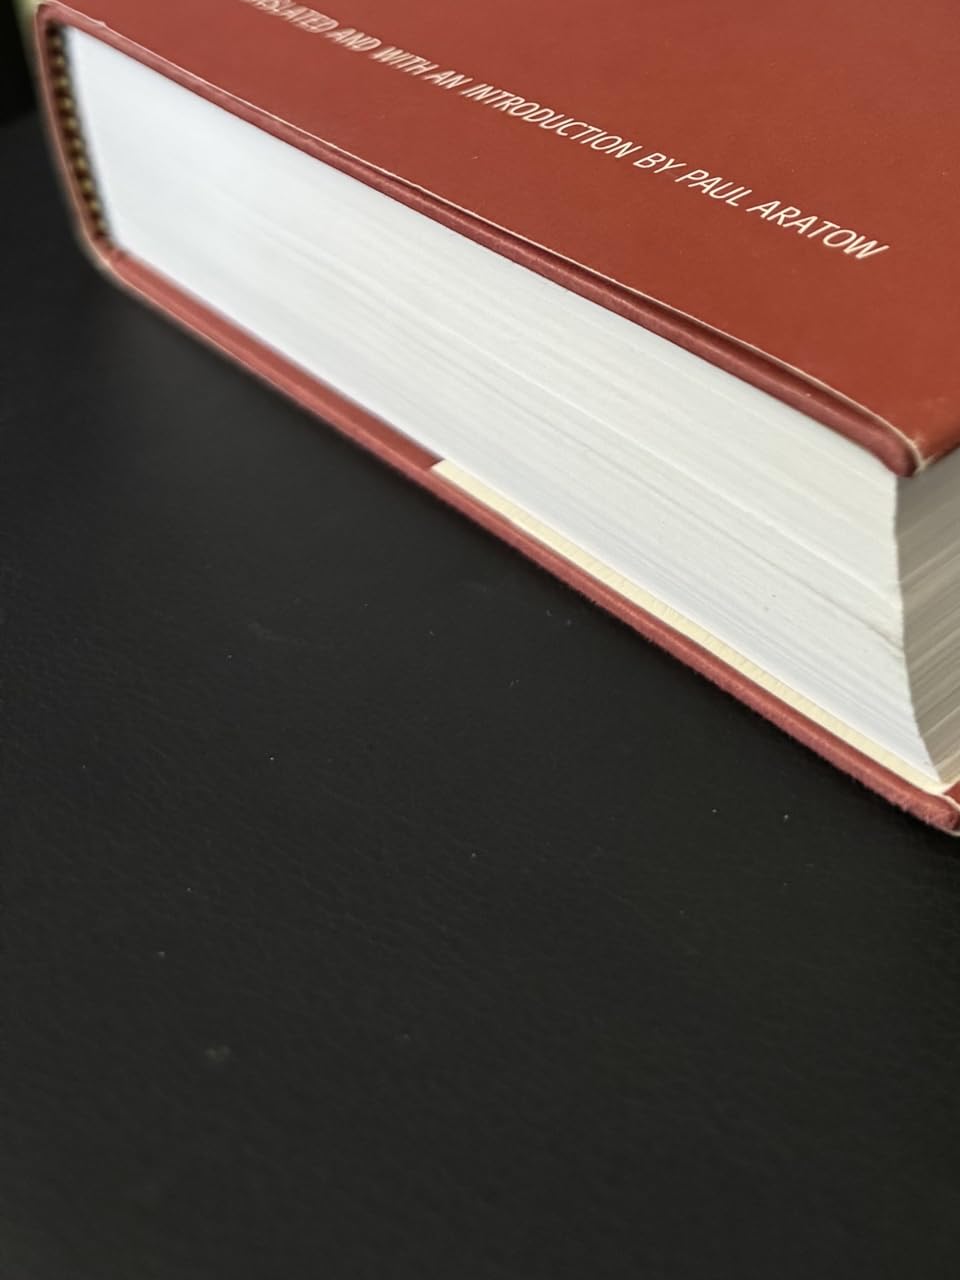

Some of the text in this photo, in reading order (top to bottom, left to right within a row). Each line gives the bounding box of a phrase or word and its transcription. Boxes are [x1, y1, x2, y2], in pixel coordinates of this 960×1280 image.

[325, 27, 383, 54] AND
[370, 46, 440, 77] WITH
[426, 70, 474, 91] AN
[460, 82, 643, 160] INTRODUCTION
[632, 152, 688, 175] BY
[674, 168, 753, 208] PAUL
[745, 199, 891, 261] ARATOW
